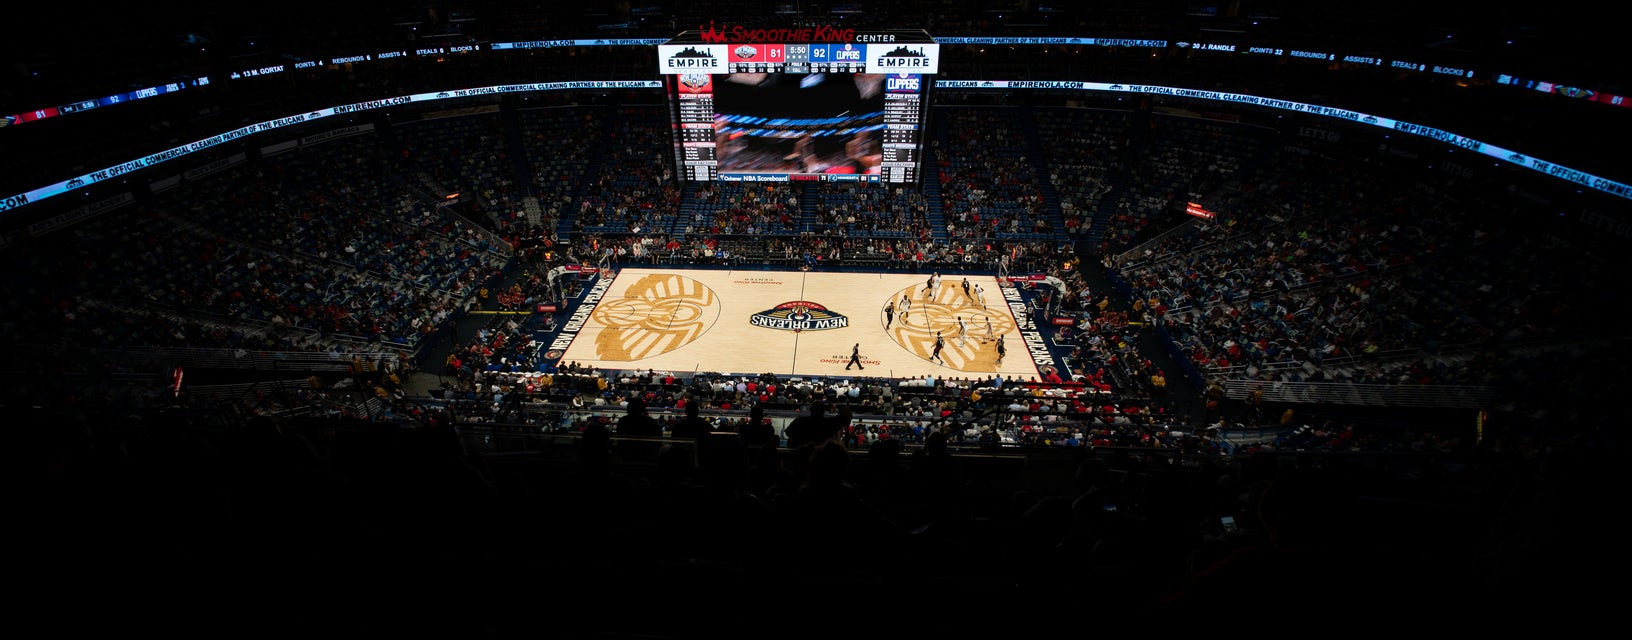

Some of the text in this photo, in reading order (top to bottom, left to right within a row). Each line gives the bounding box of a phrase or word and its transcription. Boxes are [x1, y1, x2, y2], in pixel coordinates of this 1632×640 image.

[730, 26, 812, 42] SMOOTHIE
[512, 40, 575, 49] EMPIRENOLA.COM
[1094, 38, 1165, 47] EMPIRENOLA.COM
[1208, 43, 1235, 52] RANDLE
[378, 51, 400, 59] ASSISTS
[770, 49, 781, 58] 81
[813, 49, 825, 58] 92
[836, 50, 860, 60] CLIPPERS
[1290, 50, 1327, 60] REBOUNDS
[332, 55, 364, 64] REBOUNDS
[668, 59, 718, 67] EMPIRE
[878, 58, 929, 67] EMPIRE
[1343, 55, 1374, 64] ASSISTS
[260, 65, 284, 75] GORTAT
[295, 61, 316, 69] POINTS
[1391, 60, 1417, 70] STEALS
[1432, 66, 1464, 76] BLOCKS
[468, 87, 496, 96] OFFICIAL
[497, 84, 536, 92] COMMERCIAL
[537, 82, 567, 90] CLEANING
[887, 78, 919, 90] CLIPPERS
[1007, 81, 1084, 89] EMPIRENOLA.COM
[110, 95, 120, 103] 92
[1143, 86, 1174, 95] OFFICIAL
[1175, 89, 1221, 100] COMMERCIAL
[1223, 94, 1259, 104] CLEANING
[1260, 98, 1293, 109] PARTNER
[1307, 105, 1322, 113] THE
[1323, 108, 1359, 121] PELICANS
[1611, 95, 1623, 104] 81
[333, 95, 412, 114] EMPIRENOLA.COM
[36, 109, 46, 119] 81
[1394, 121, 1481, 151] EMPIRENOLA.COM
[90, 170, 108, 183] THE
[110, 160, 145, 176] OFFICIAL
[145, 144, 191, 164] COMMERCIAL
[191, 135, 223, 151] CLEANING
[222, 127, 249, 141] PARTNER
[249, 125, 257, 134] OF
[258, 122, 273, 131] THE
[273, 114, 305, 128] PELICANS
[1533, 160, 1632, 198] THE OFFICIAL COMME
[549, 333, 575, 350] NEW
[563, 304, 595, 331] ORLEANS
[751, 315, 847, 329] NEW ORLEANS
[1001, 287, 1023, 301] NEW
[1022, 331, 1054, 365] PELICANS
